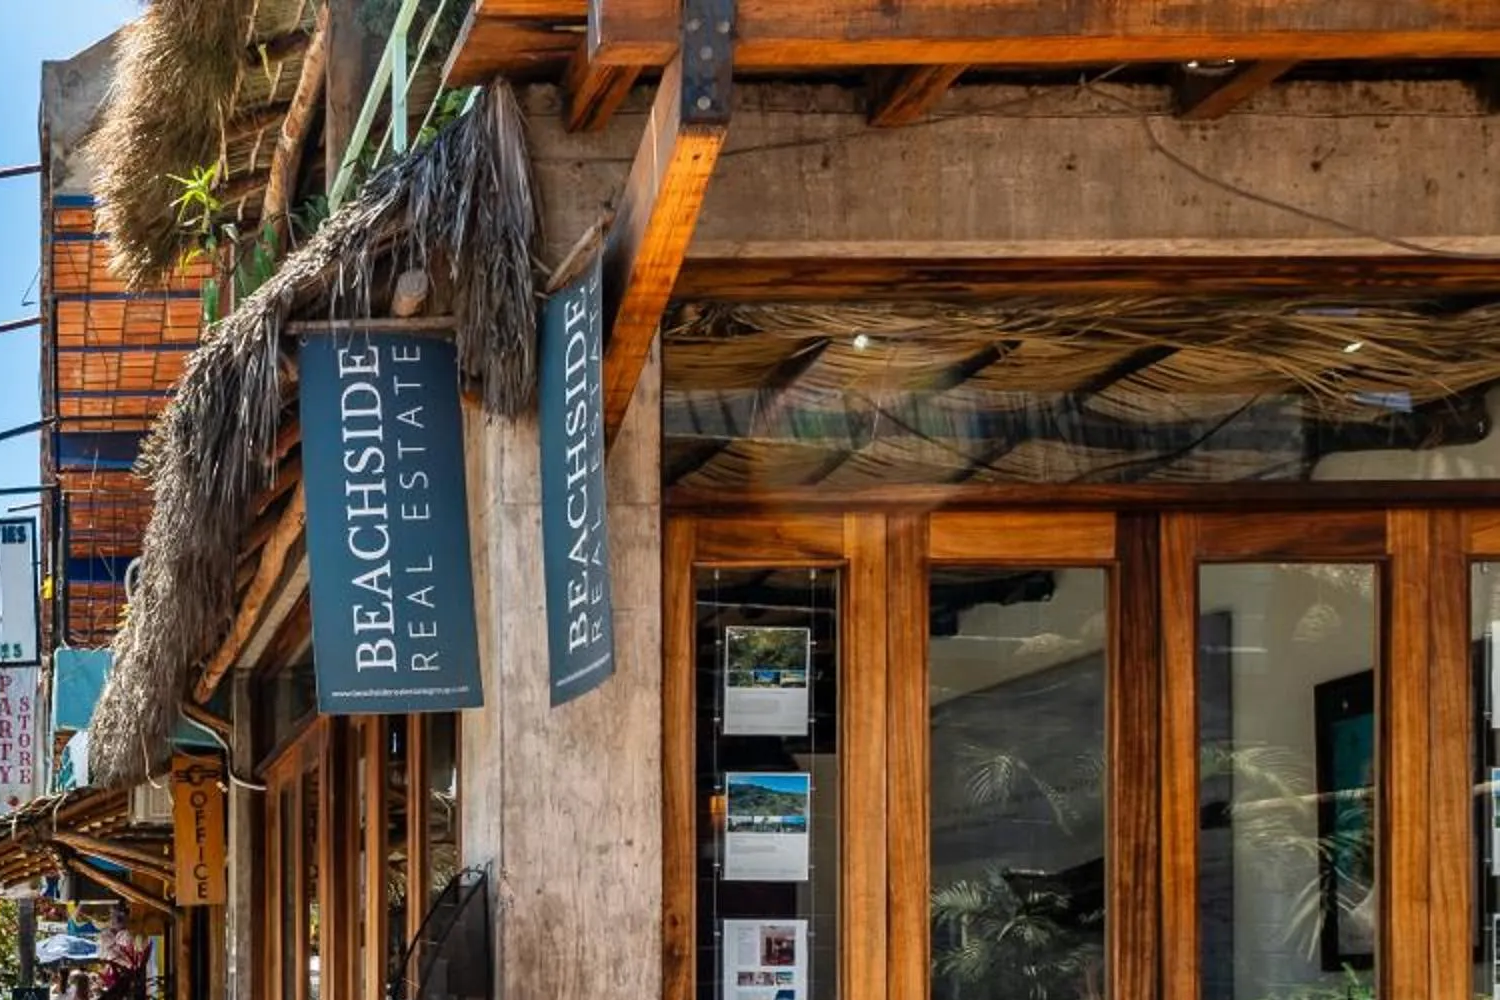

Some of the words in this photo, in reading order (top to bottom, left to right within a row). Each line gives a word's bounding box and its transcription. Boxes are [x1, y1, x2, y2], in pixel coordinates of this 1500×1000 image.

[393, 344, 429, 521] ESTATE
[564, 286, 589, 654] BEACHSIDE
[338, 344, 397, 673] BEACHSIDE
[405, 555, 441, 671] REAL
[18, 696, 31, 784] STORE
[189, 790, 209, 899] OFFICE
